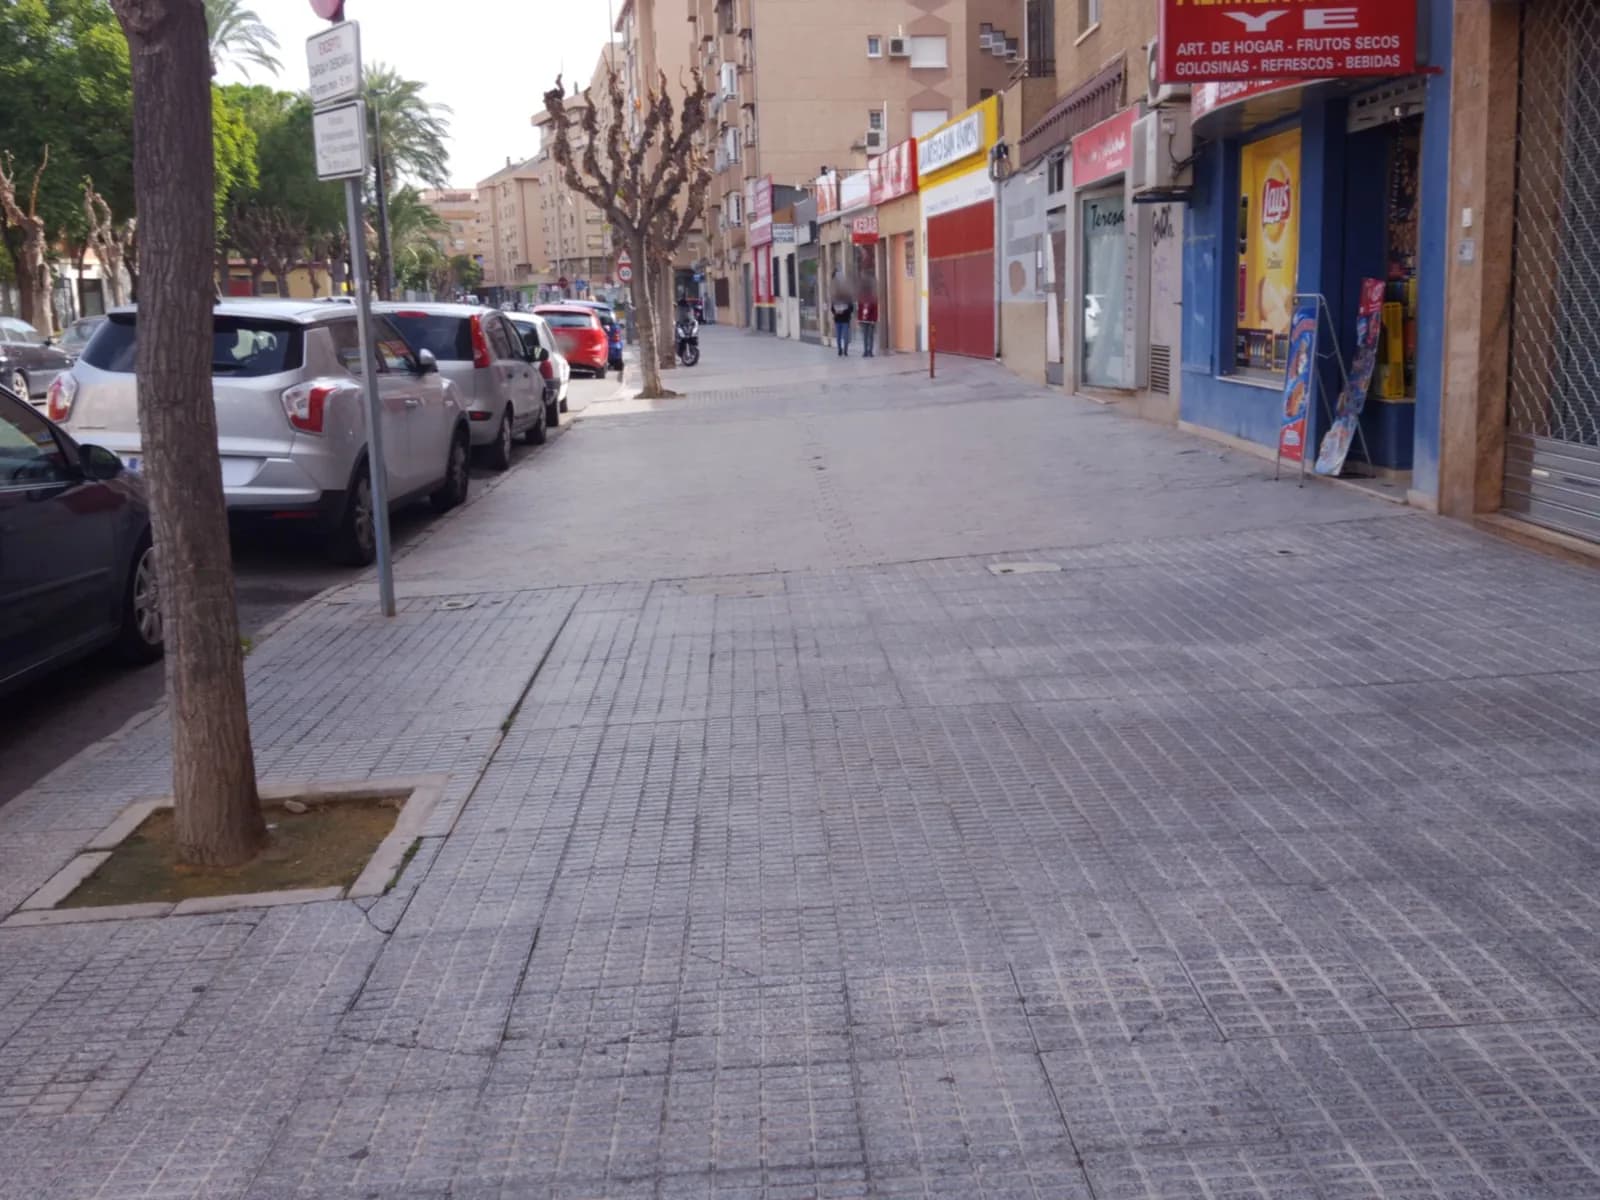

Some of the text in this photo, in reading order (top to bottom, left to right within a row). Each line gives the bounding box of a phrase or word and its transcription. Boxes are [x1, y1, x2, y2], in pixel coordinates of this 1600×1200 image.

[1176, 42, 1208, 56] ART.
[1211, 41, 1230, 55] DE
[1234, 39, 1284, 54] HOGAR
[1296, 37, 1351, 51] FRUTOS
[1355, 35, 1400, 49] SECOS
[1176, 60, 1249, 76] GOLOSINAS
[1261, 57, 1334, 72] REFRESCOS
[1345, 54, 1400, 69] BEBIDAS
[1091, 204, 1125, 230] Teresa
